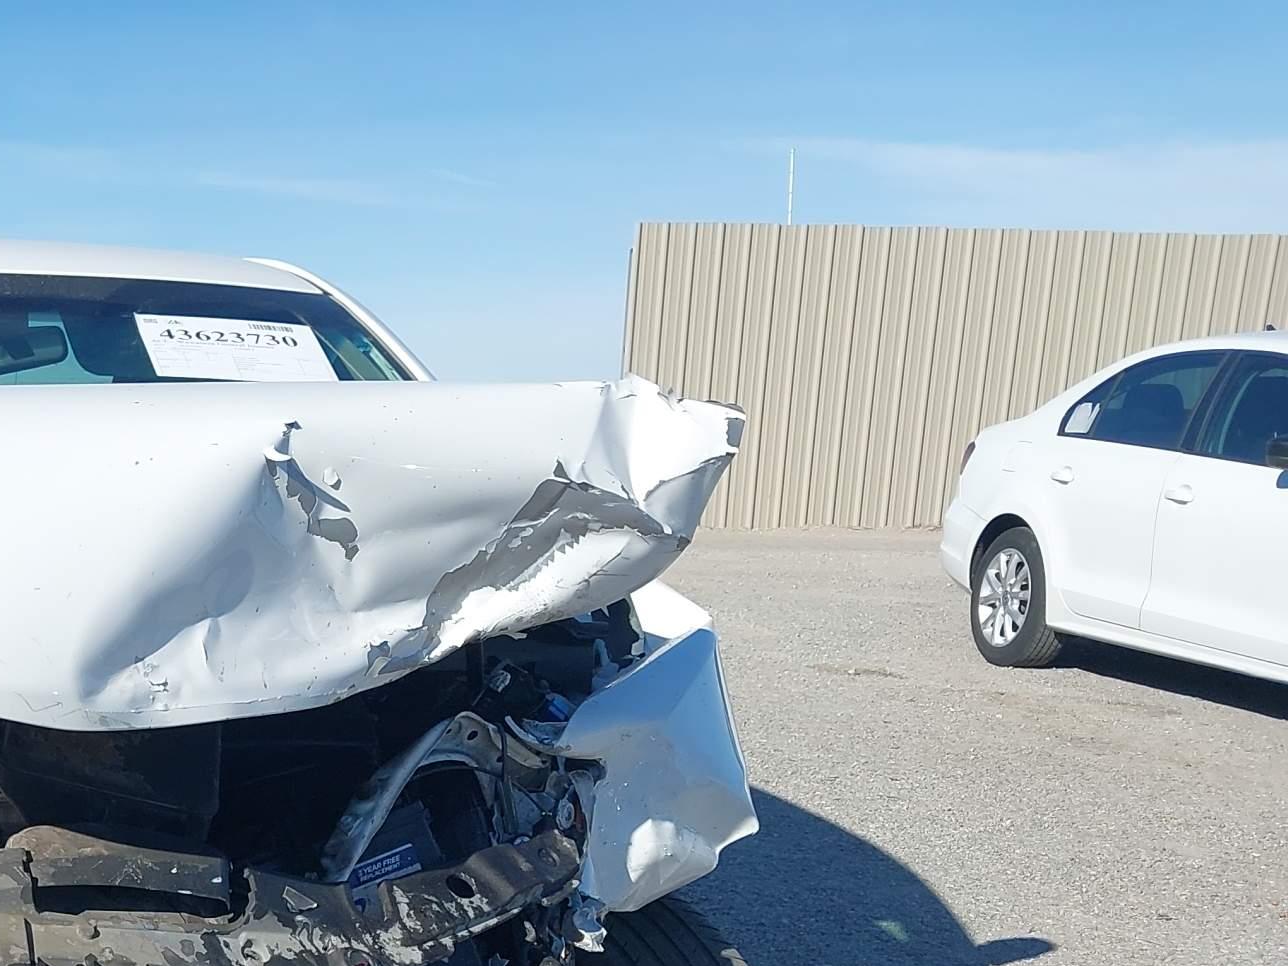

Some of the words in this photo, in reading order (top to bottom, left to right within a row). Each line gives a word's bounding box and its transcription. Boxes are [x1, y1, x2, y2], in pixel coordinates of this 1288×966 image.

[159, 328, 299, 348] 43623730
[363, 862, 382, 873] YEAR
[382, 855, 401, 867] FREE
